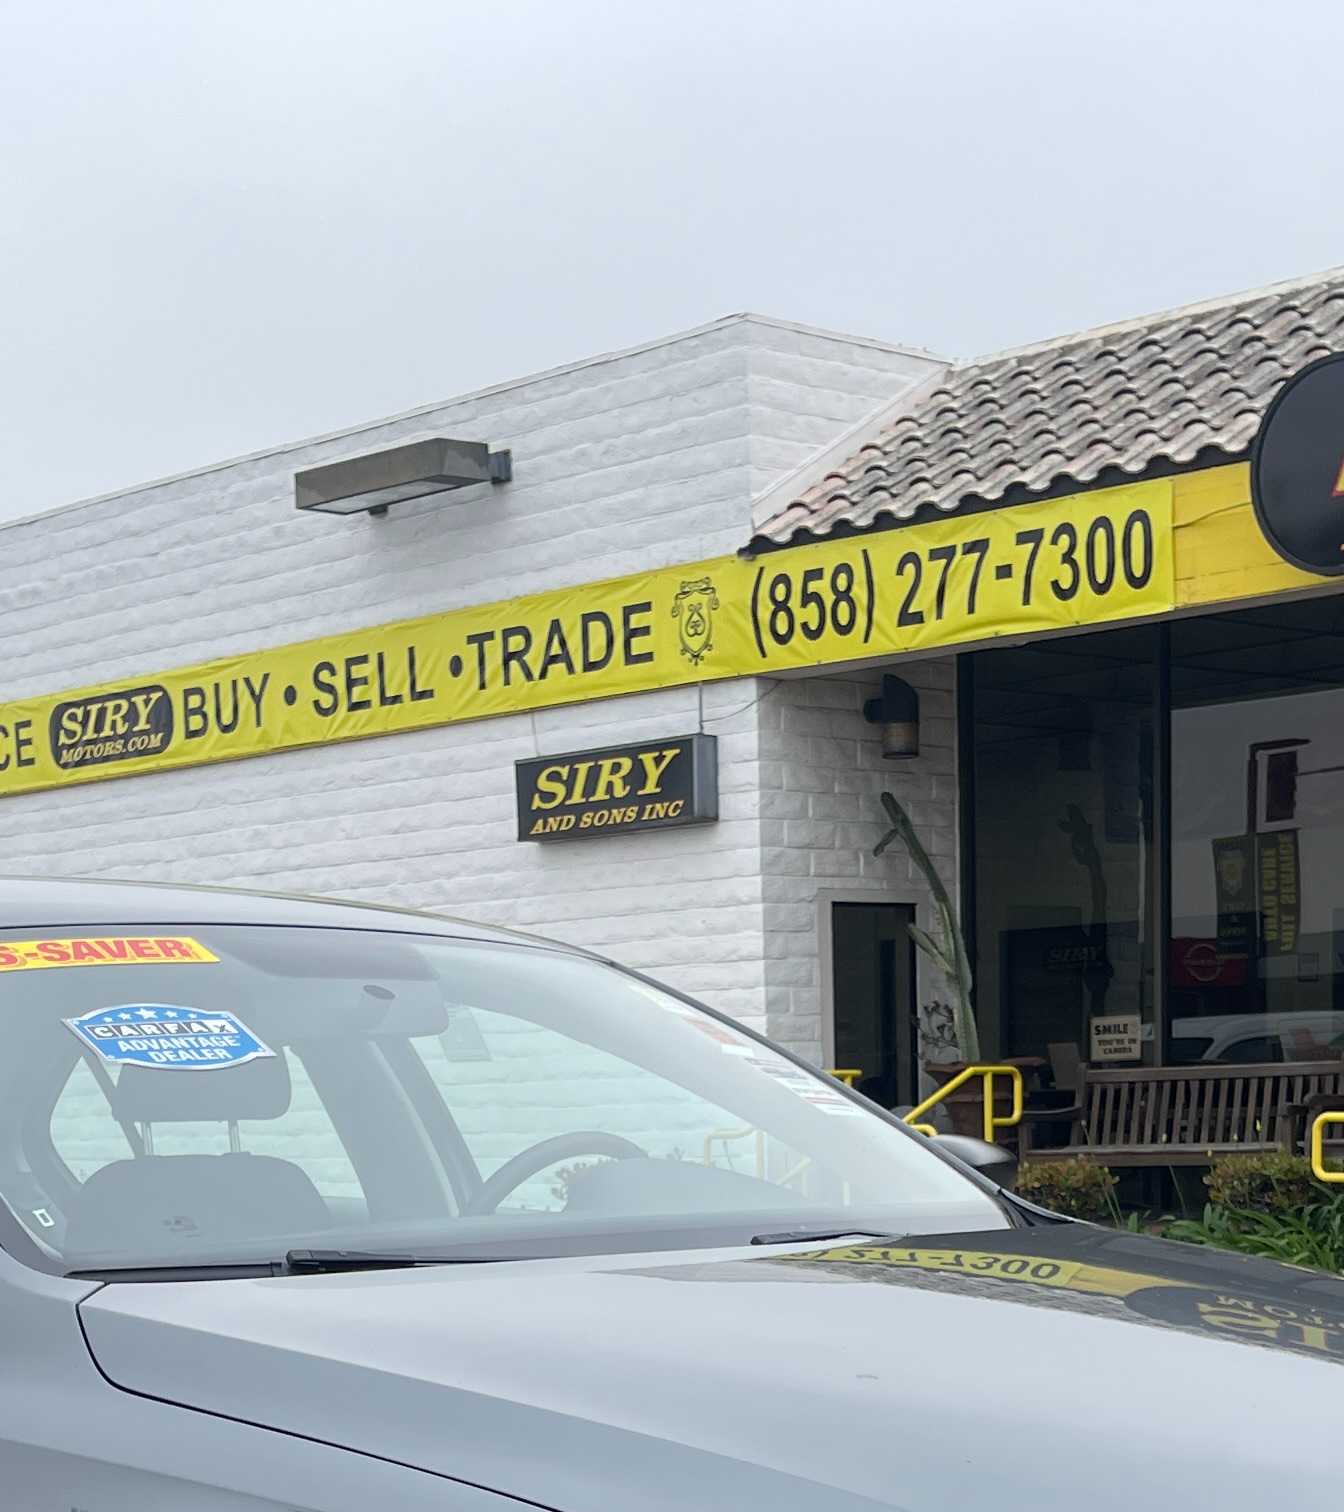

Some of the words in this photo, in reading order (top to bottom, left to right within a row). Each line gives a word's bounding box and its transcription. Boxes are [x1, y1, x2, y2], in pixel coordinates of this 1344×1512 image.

[751, 548, 875, 658] (858)
[895, 509, 1153, 628] 277-7300
[183, 673, 270, 740] BUY
[312, 645, 435, 717] SELL
[466, 603, 654, 691] TRADE
[58, 691, 163, 748] SIRY
[59, 730, 163, 764] MOTORS.COM
[530, 747, 679, 811] SIRY
[530, 814, 576, 836] AND
[579, 807, 637, 830] SONS
[642, 800, 683, 823] INC
[93, 1020, 239, 1038] CARFAX
[117, 1035, 240, 1053] ADVANTAGE
[1094, 1023, 1129, 1036] SMILE
[147, 1048, 233, 1064] DEALER
